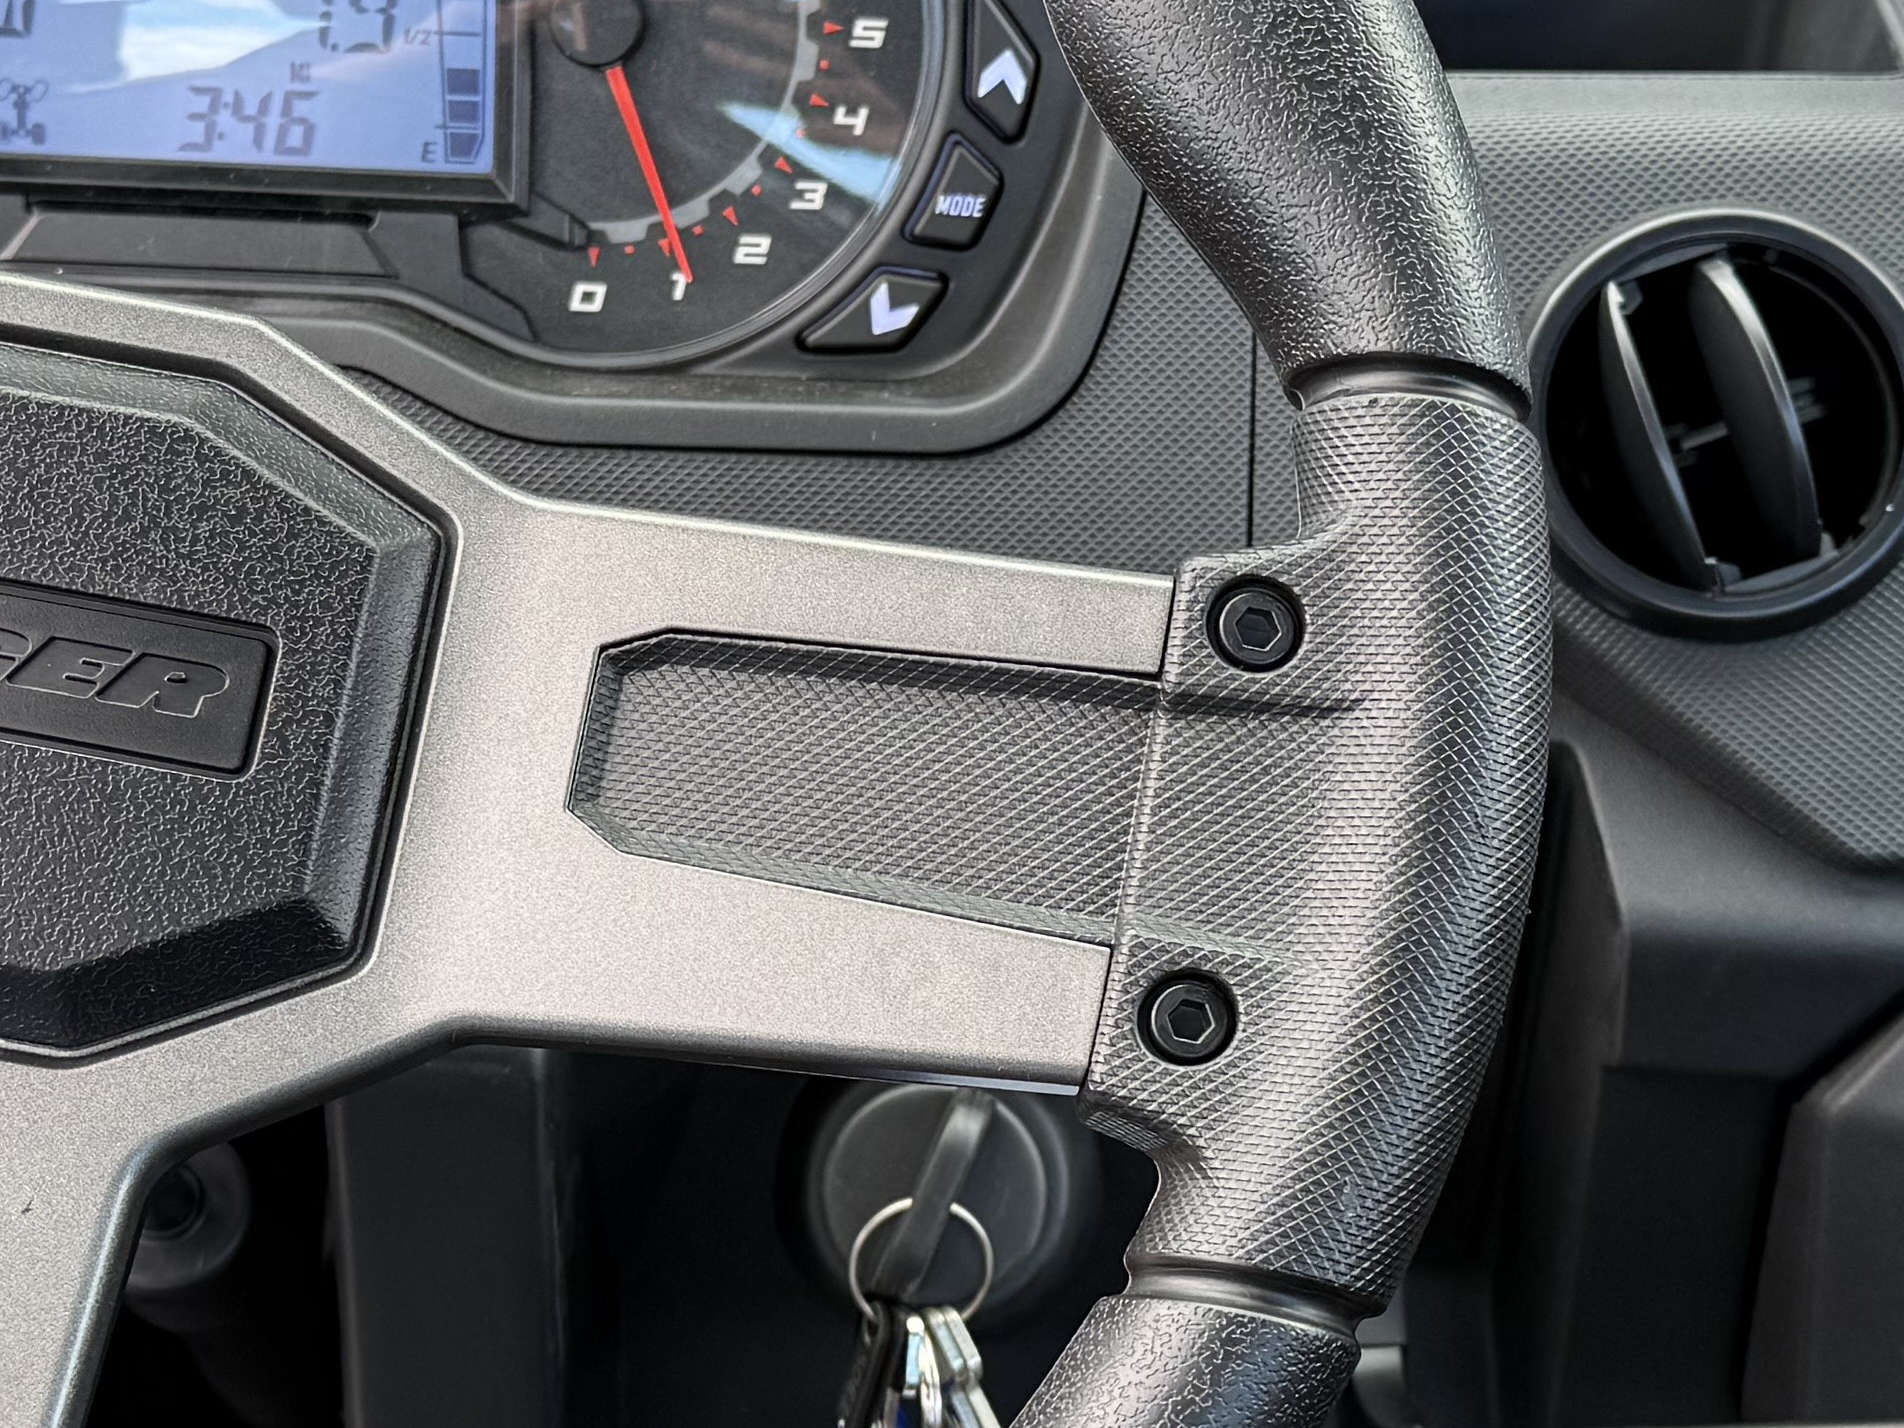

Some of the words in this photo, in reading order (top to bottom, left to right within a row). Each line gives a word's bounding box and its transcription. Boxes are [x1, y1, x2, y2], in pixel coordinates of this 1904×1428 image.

[849, 18, 888, 48] 5
[178, 85, 320, 157] 3:46
[833, 105, 869, 135] 4
[421, 141, 438, 163] E
[789, 180, 827, 210] 3
[935, 193, 986, 219] MODE
[732, 233, 772, 265] 2
[569, 282, 607, 313] 0
[670, 272, 688, 302] 1
